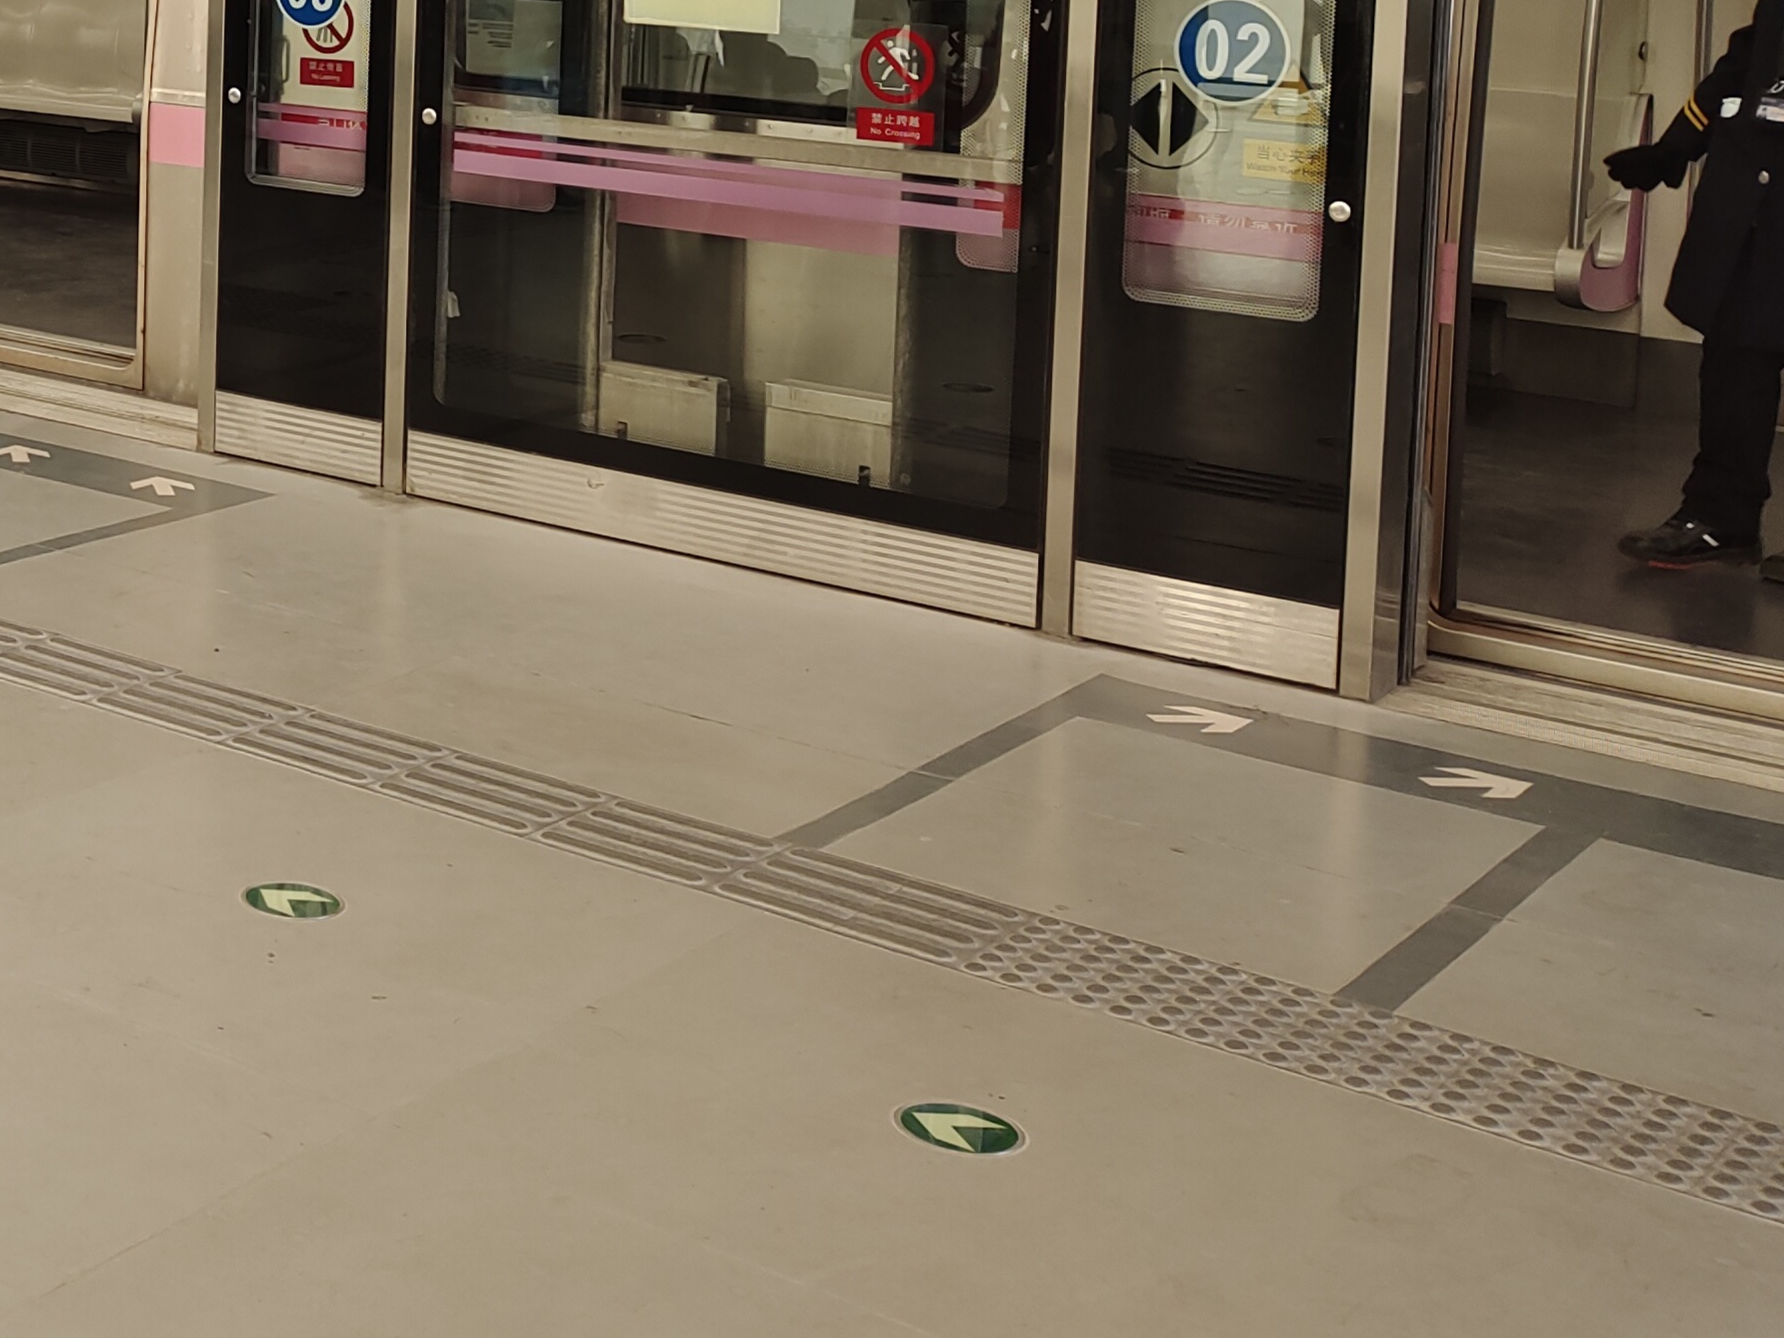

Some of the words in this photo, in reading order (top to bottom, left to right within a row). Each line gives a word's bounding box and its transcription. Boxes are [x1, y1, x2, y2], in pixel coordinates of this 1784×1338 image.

[1194, 18, 1272, 84] 02
[871, 112, 920, 128] 禁止跨越
[869, 127, 882, 135] No
[884, 128, 921, 141] Crossing
